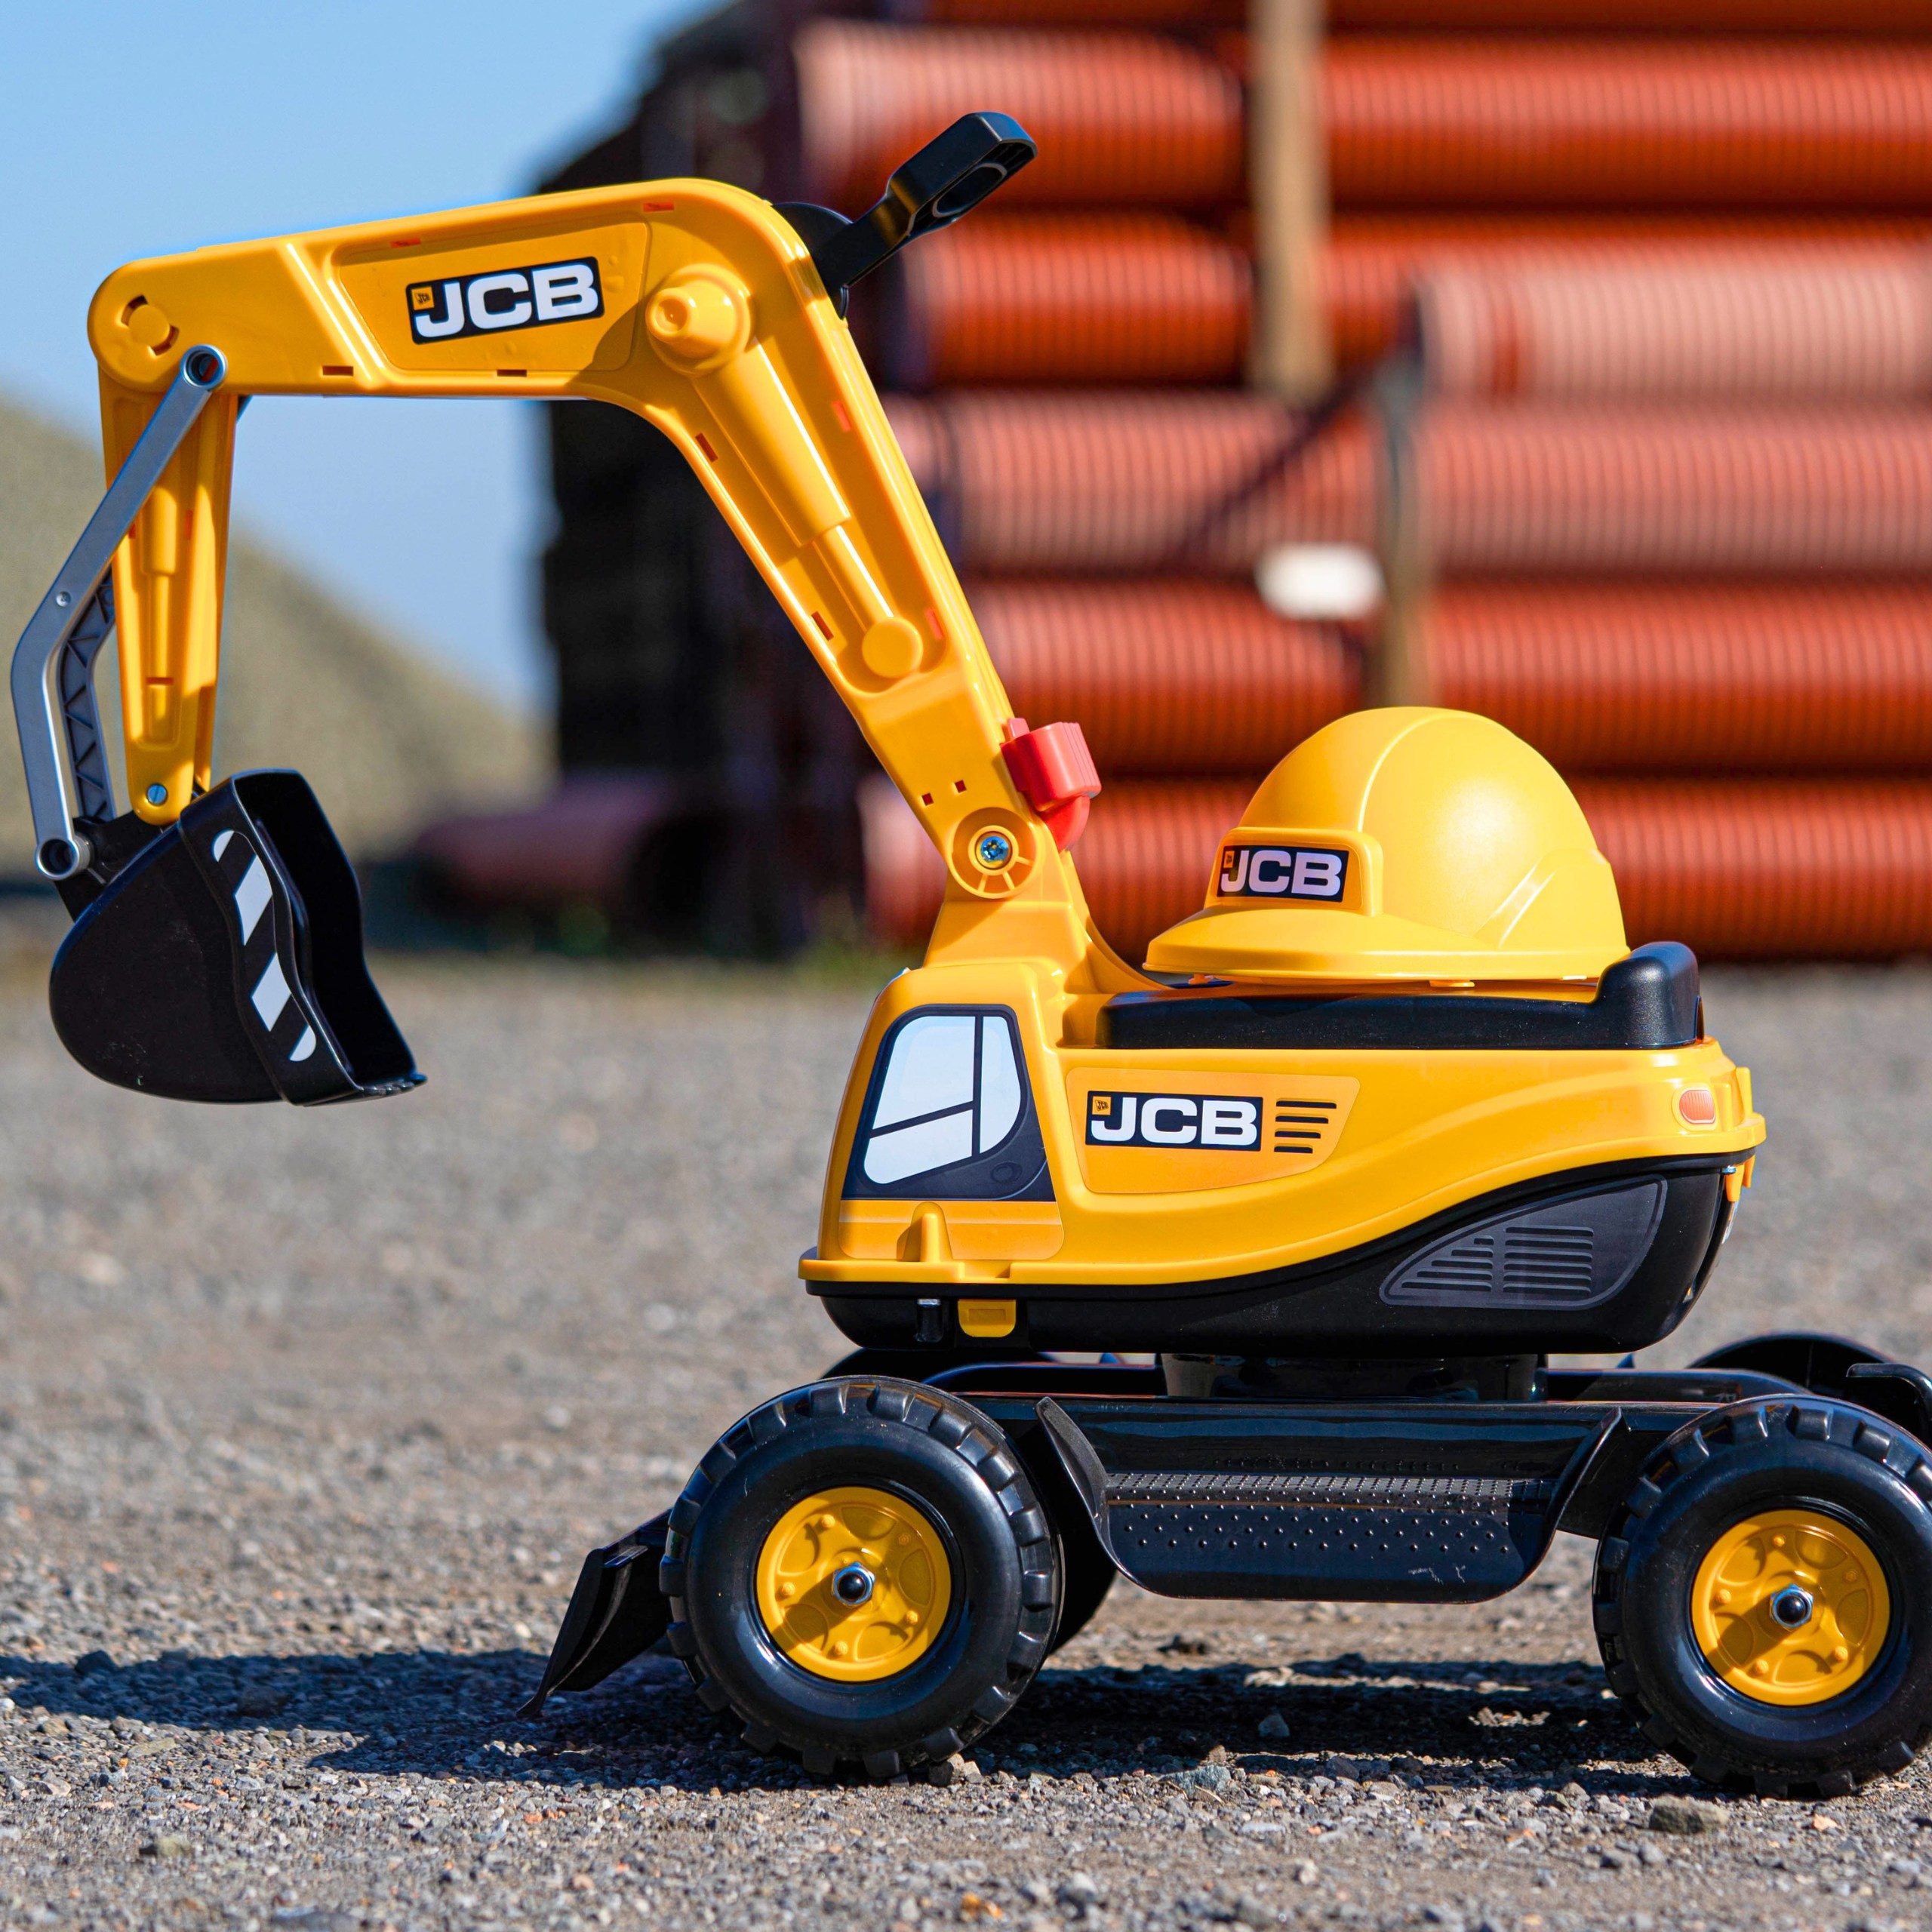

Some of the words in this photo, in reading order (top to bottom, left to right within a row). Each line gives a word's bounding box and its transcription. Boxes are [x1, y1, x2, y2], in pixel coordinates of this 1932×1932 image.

[414, 263, 598, 338] JCB
[1220, 850, 1343, 897] JCB
[1091, 1097, 1257, 1146] JCB
